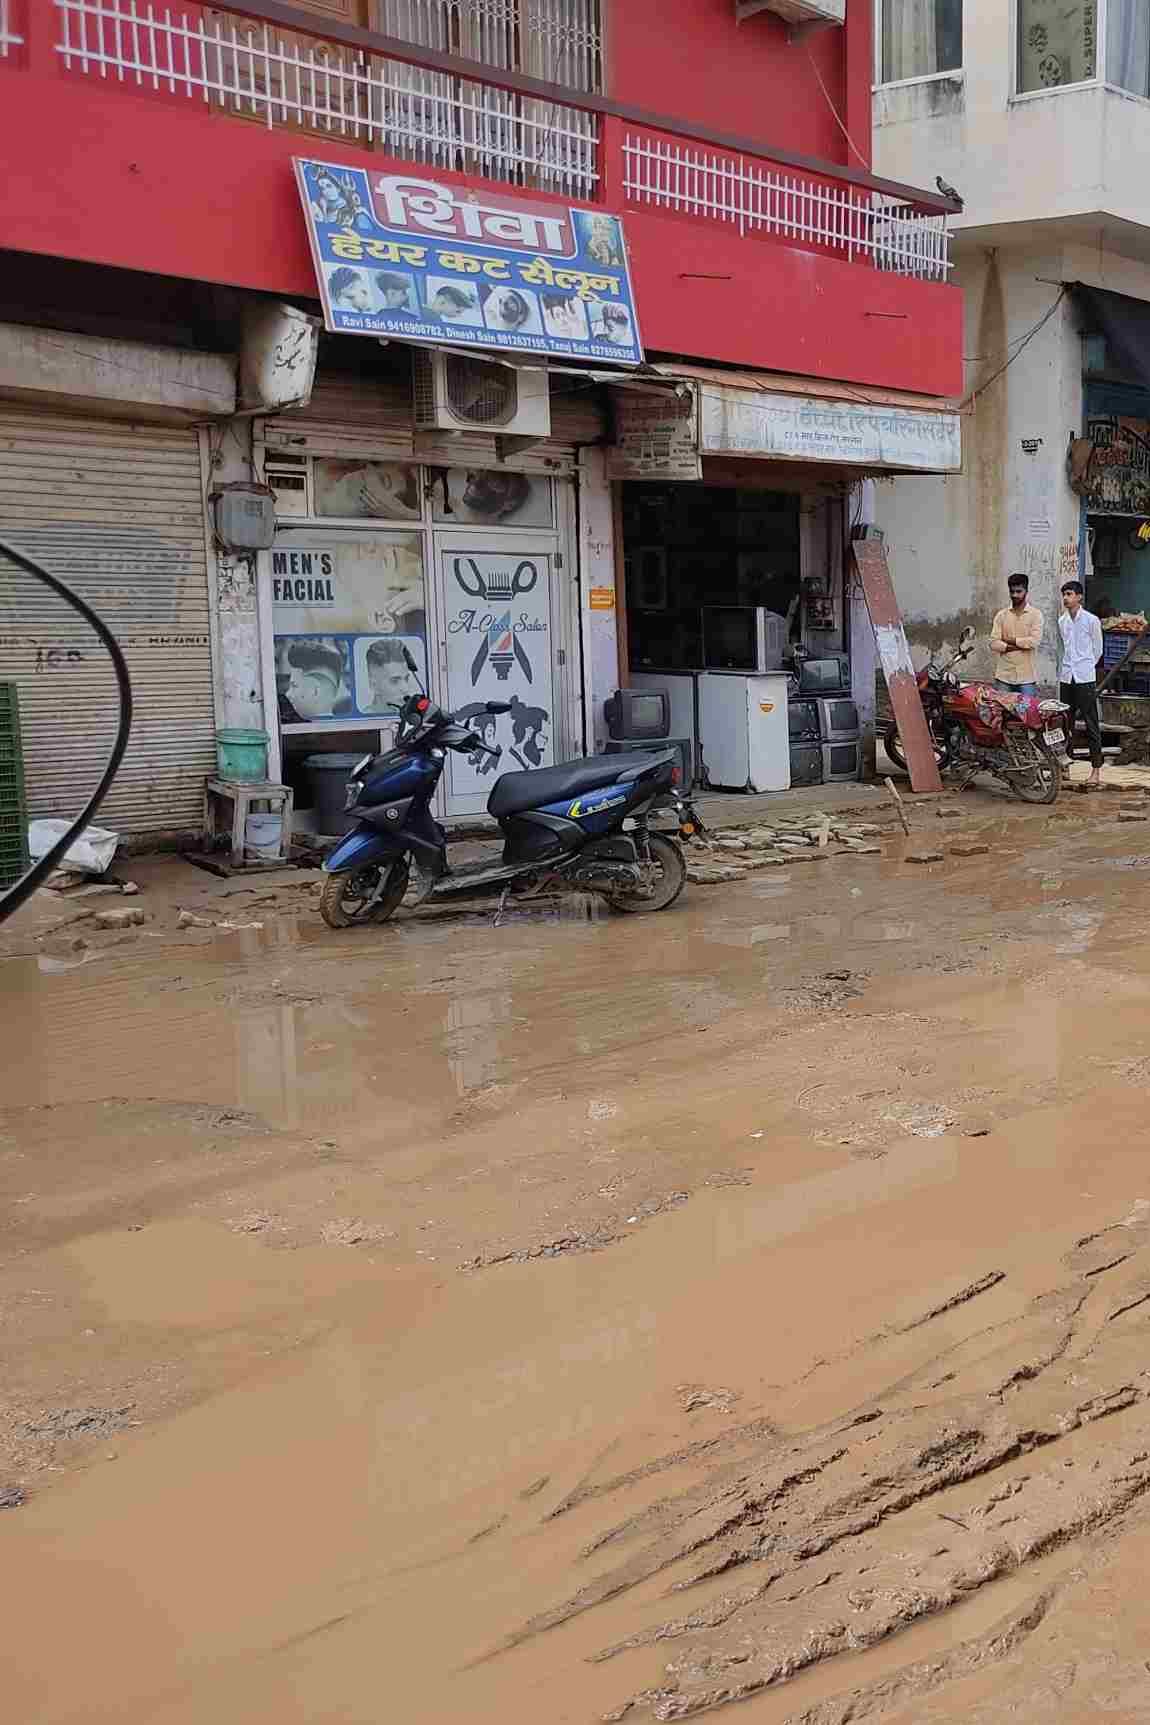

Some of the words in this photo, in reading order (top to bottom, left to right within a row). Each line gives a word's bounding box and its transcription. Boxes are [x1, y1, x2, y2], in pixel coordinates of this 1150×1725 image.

[374, 176, 567, 250] शिवा
[329, 230, 428, 267] हेयर
[437, 249, 511, 279] कट
[519, 256, 620, 303] सैलून
[342, 317, 363, 328] Ravi
[365, 318, 386, 330] Sain
[272, 553, 332, 575] MEN'S
[273, 579, 334, 601] FACIAL
